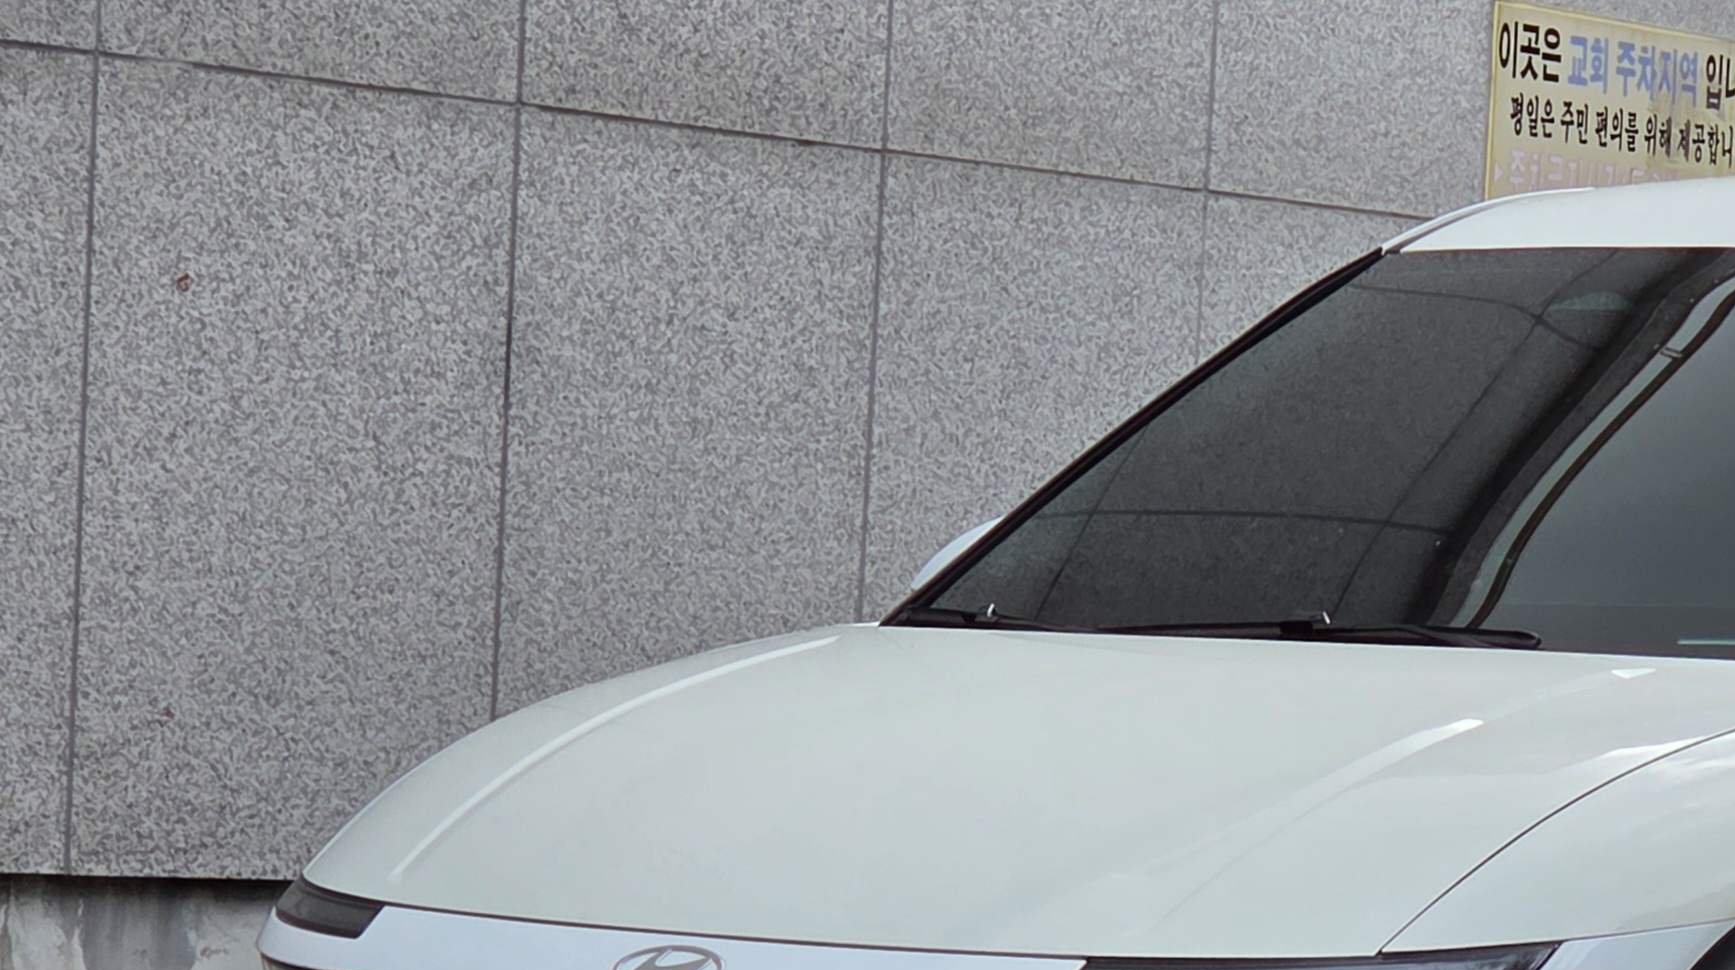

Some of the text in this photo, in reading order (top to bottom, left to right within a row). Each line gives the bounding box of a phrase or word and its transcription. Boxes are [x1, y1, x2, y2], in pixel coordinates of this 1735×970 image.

[1499, 21, 1562, 83] 이곳은
[1567, 35, 1609, 95] 교회
[1615, 41, 1699, 109] 주차지역
[1510, 92, 1555, 138] 평일은
[1560, 100, 1589, 144] 주민
[1595, 107, 1639, 152] 편의를
[1644, 114, 1672, 158] 위해
